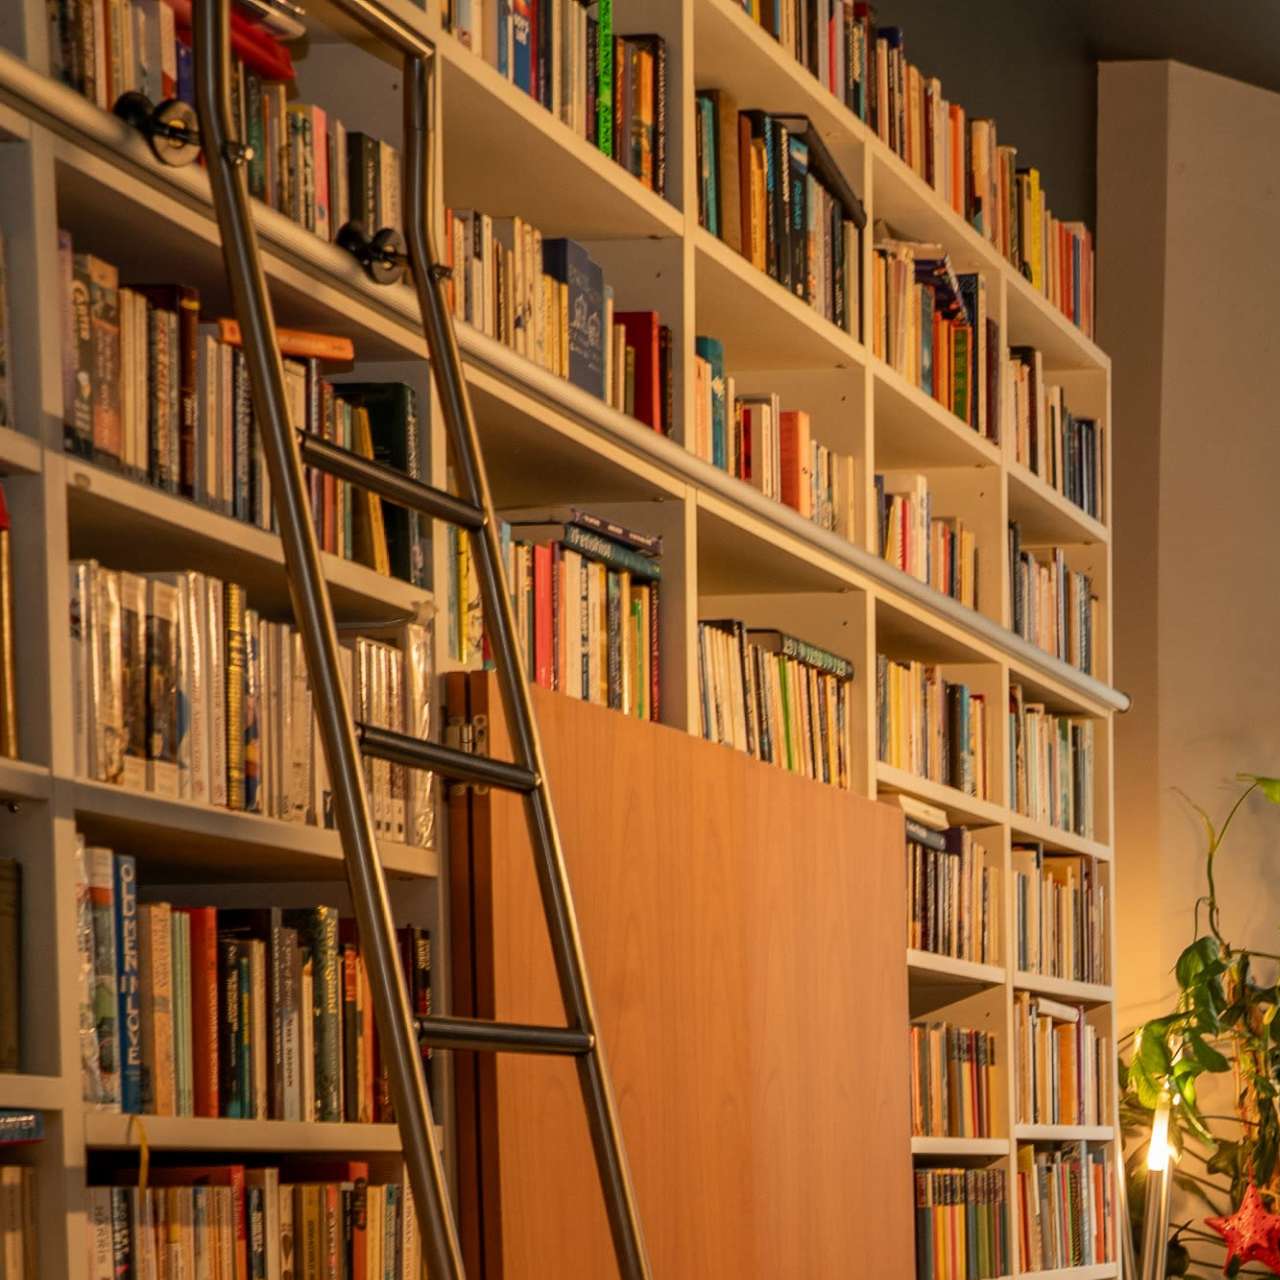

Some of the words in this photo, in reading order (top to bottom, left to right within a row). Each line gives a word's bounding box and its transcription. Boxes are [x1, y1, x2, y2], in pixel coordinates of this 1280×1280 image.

[324, 947, 338, 1014] England
[127, 994, 142, 1065] LOVE
[95, 1205, 110, 1265] HARRIS
